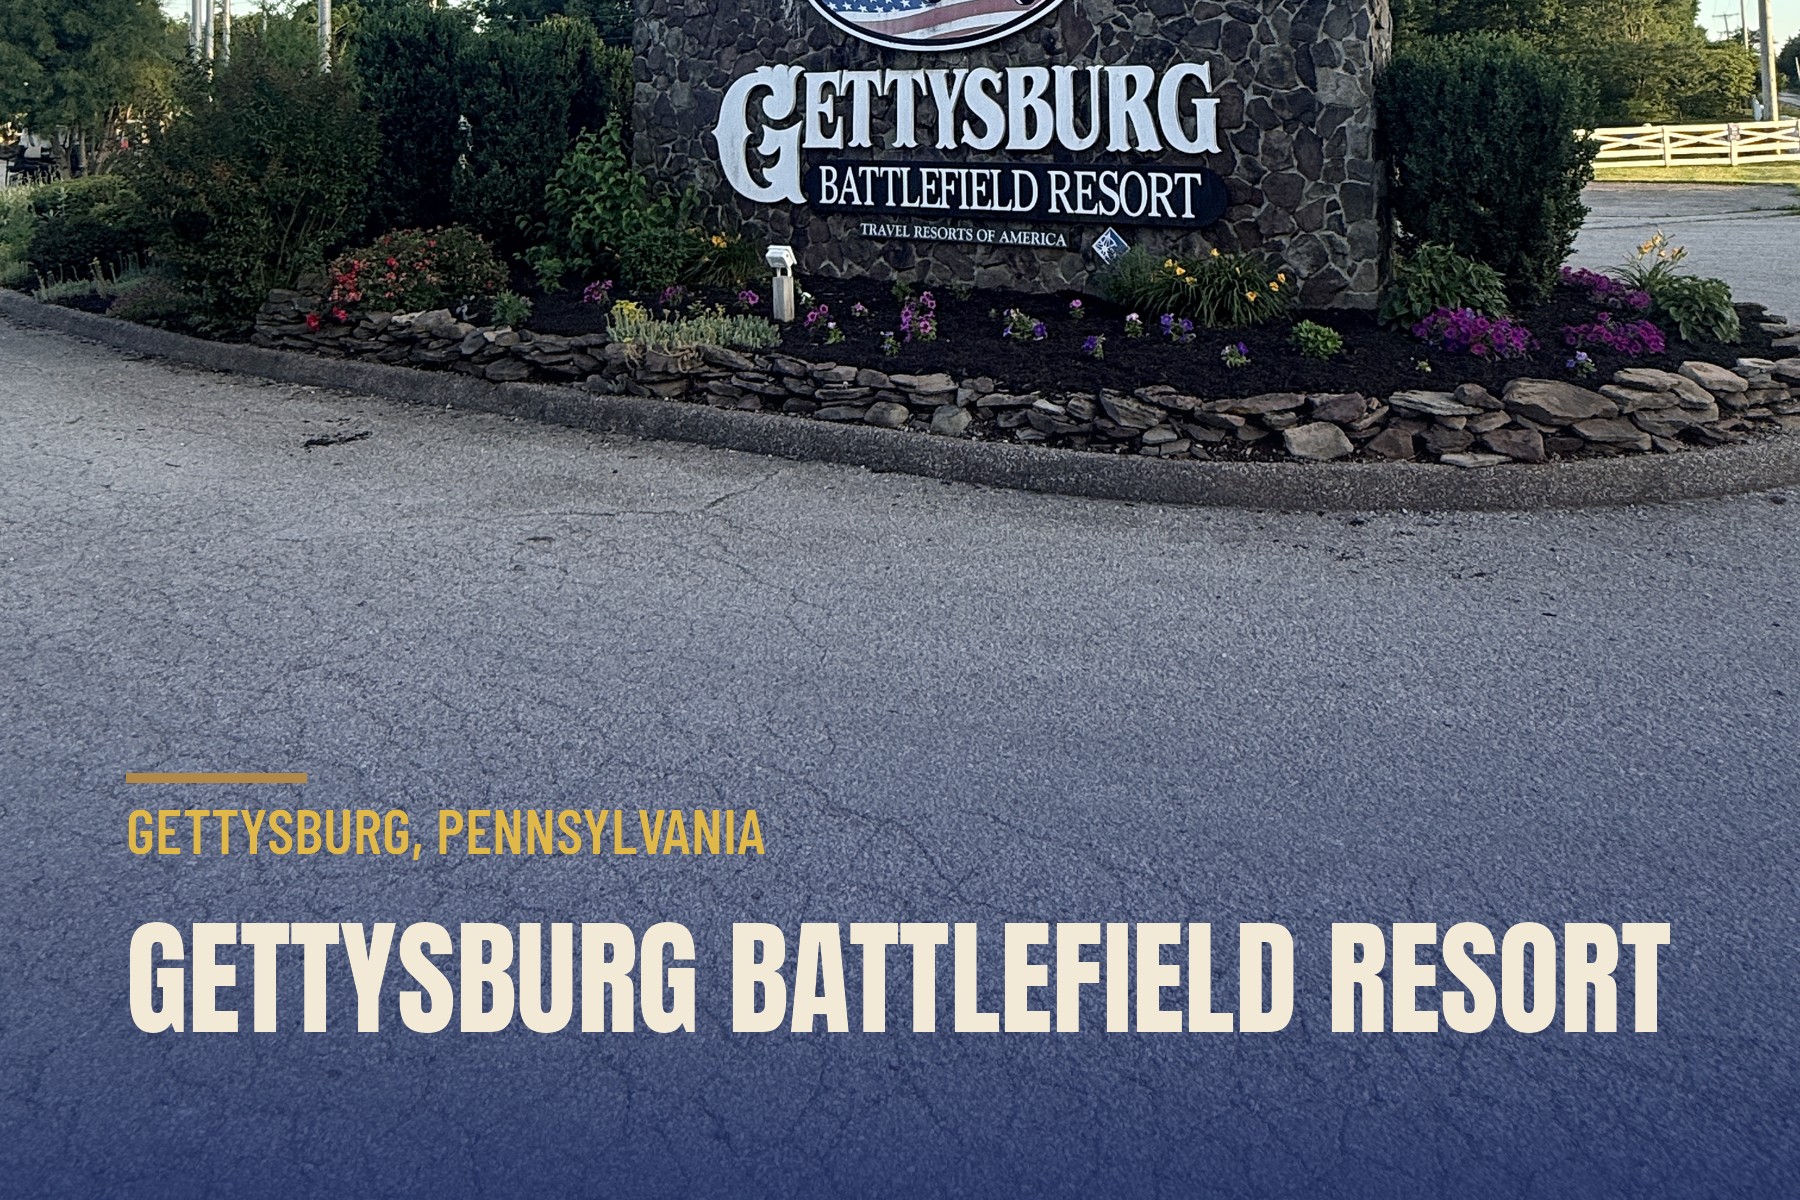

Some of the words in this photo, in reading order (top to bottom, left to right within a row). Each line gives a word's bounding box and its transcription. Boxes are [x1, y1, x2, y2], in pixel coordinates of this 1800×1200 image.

[711, 60, 1221, 204] GETTYSBURG
[818, 166, 1039, 212] BATTLEFIELD
[1048, 171, 1202, 219] RESORT
[860, 222, 911, 238] TRAVEL
[913, 225, 973, 242] RESORTS
[976, 228, 996, 243] OF
[999, 230, 1068, 247] AMERICA
